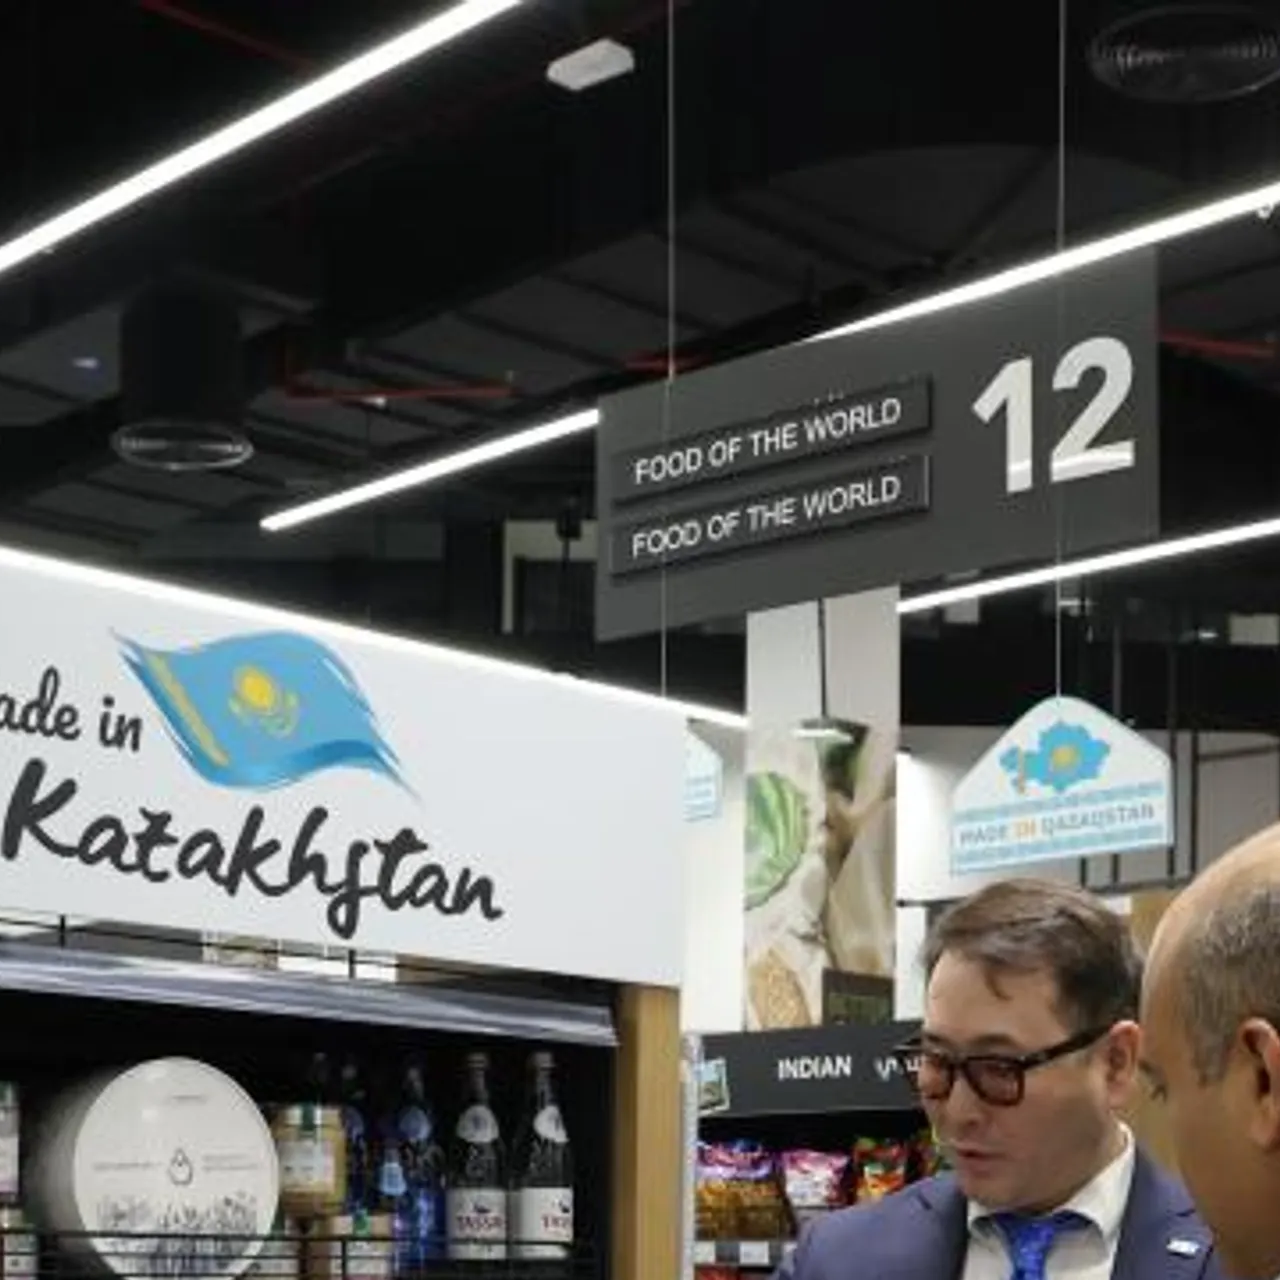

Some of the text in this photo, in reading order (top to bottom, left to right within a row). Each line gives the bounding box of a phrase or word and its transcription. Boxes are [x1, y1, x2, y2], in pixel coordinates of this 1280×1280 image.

[633, 396, 903, 486] FOOD OF THE WORLD
[971, 336, 1135, 495] 12
[630, 474, 903, 560] FOOD OF THE WORLD
[98, 695, 143, 753] in
[0, 757, 504, 940] Kazakhstan
[959, 824, 1008, 848] MADE
[1014, 819, 1037, 839] IN
[777, 1054, 852, 1081] INDIAN
